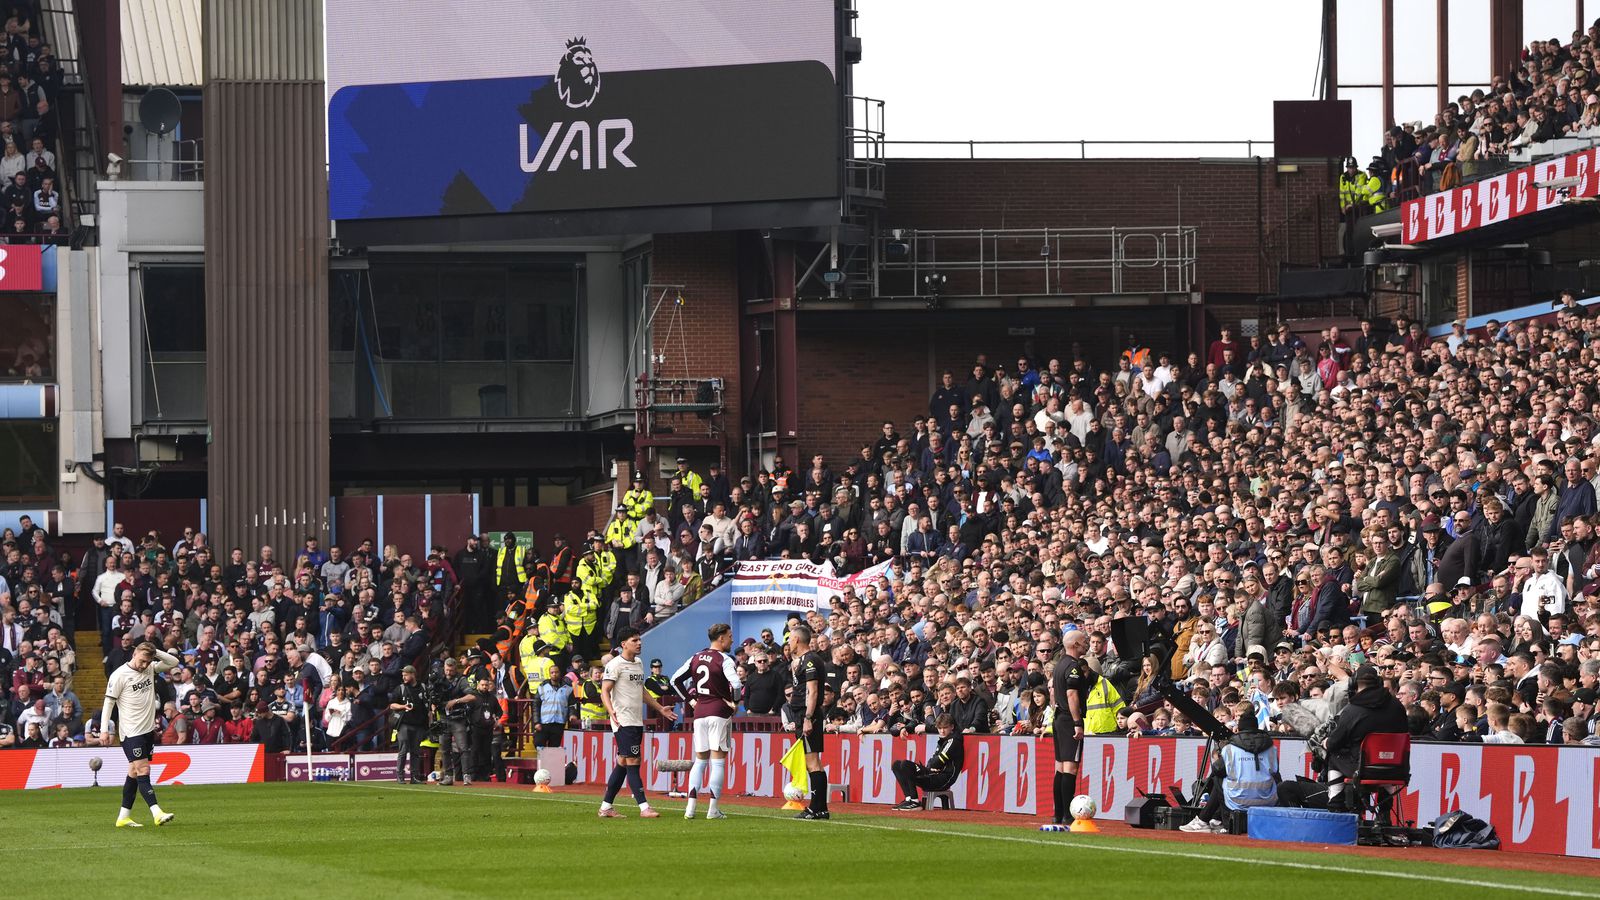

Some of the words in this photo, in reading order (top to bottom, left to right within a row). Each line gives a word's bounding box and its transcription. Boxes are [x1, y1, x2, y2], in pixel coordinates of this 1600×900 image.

[519, 118, 638, 173] VAR
[739, 564, 768, 572] EAST
[771, 563, 792, 571] END
[731, 596, 758, 606] FOREVER
[759, 596, 786, 605] BLOWING
[787, 596, 815, 609] BUBBLES
[696, 665, 710, 695] 2
